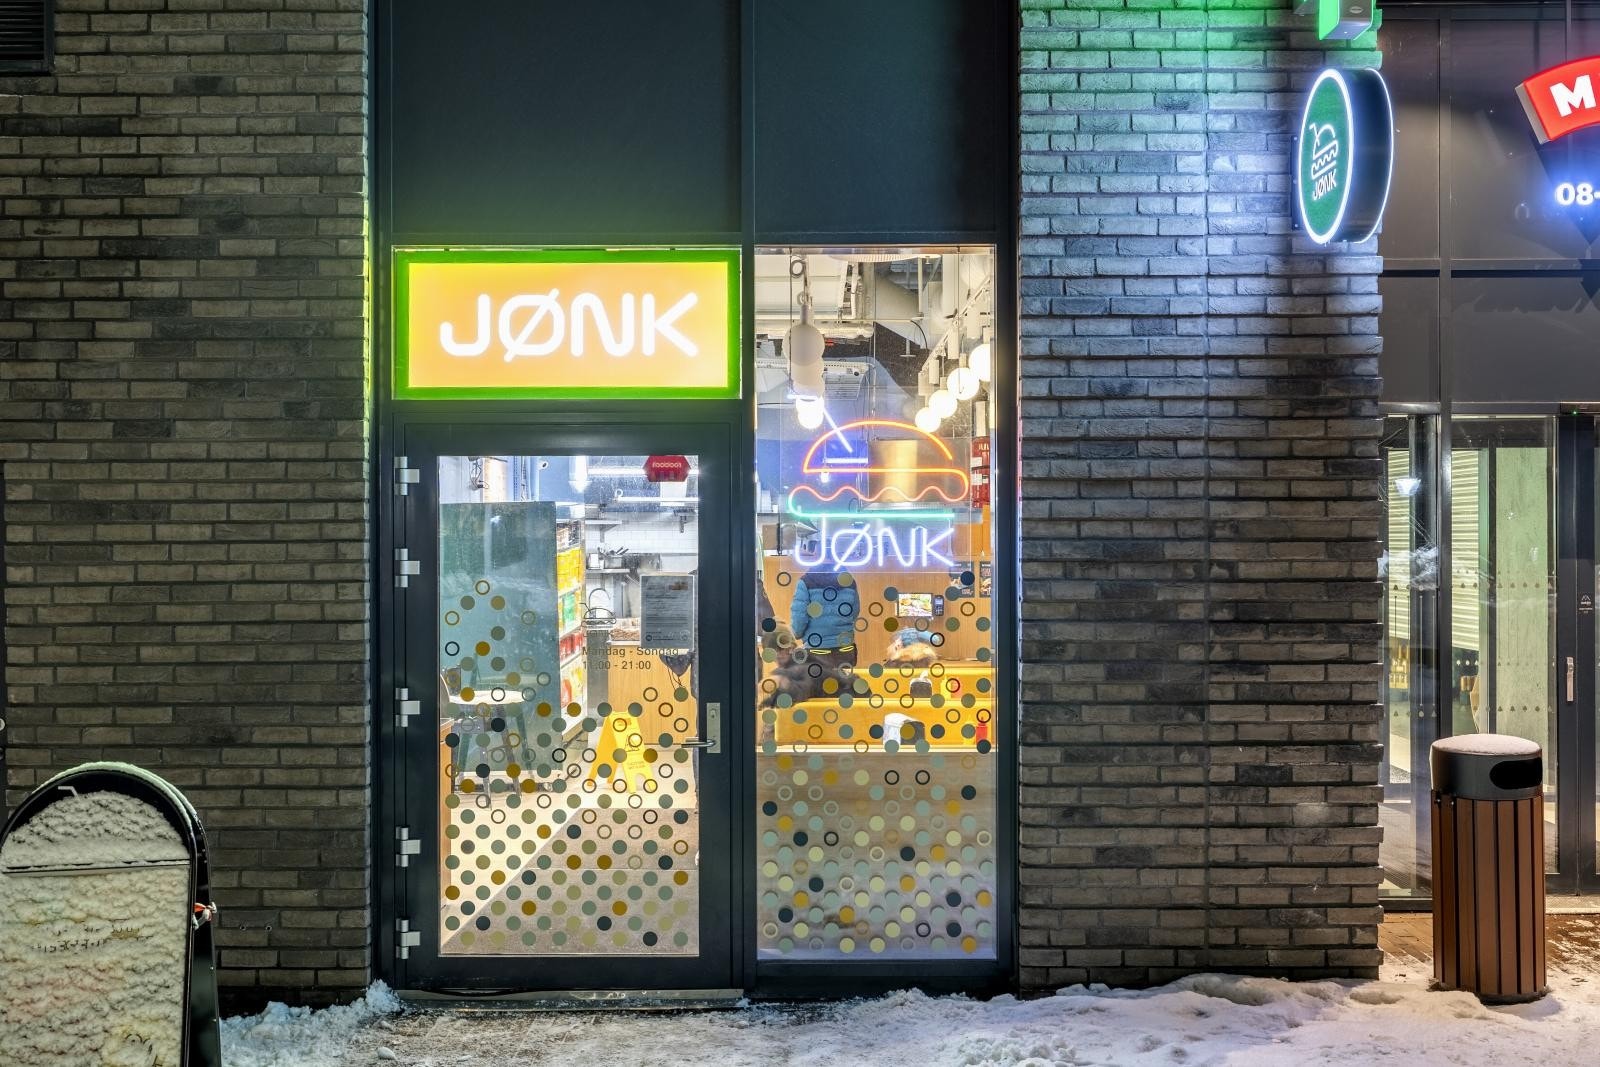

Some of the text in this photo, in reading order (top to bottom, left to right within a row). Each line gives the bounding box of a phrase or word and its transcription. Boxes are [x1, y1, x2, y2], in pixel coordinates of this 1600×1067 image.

[1312, 168, 1337, 201] JØNK
[440, 288, 698, 362] JØNK
[794, 515, 955, 572] JØNK
[621, 660, 652, 670] 21:00
